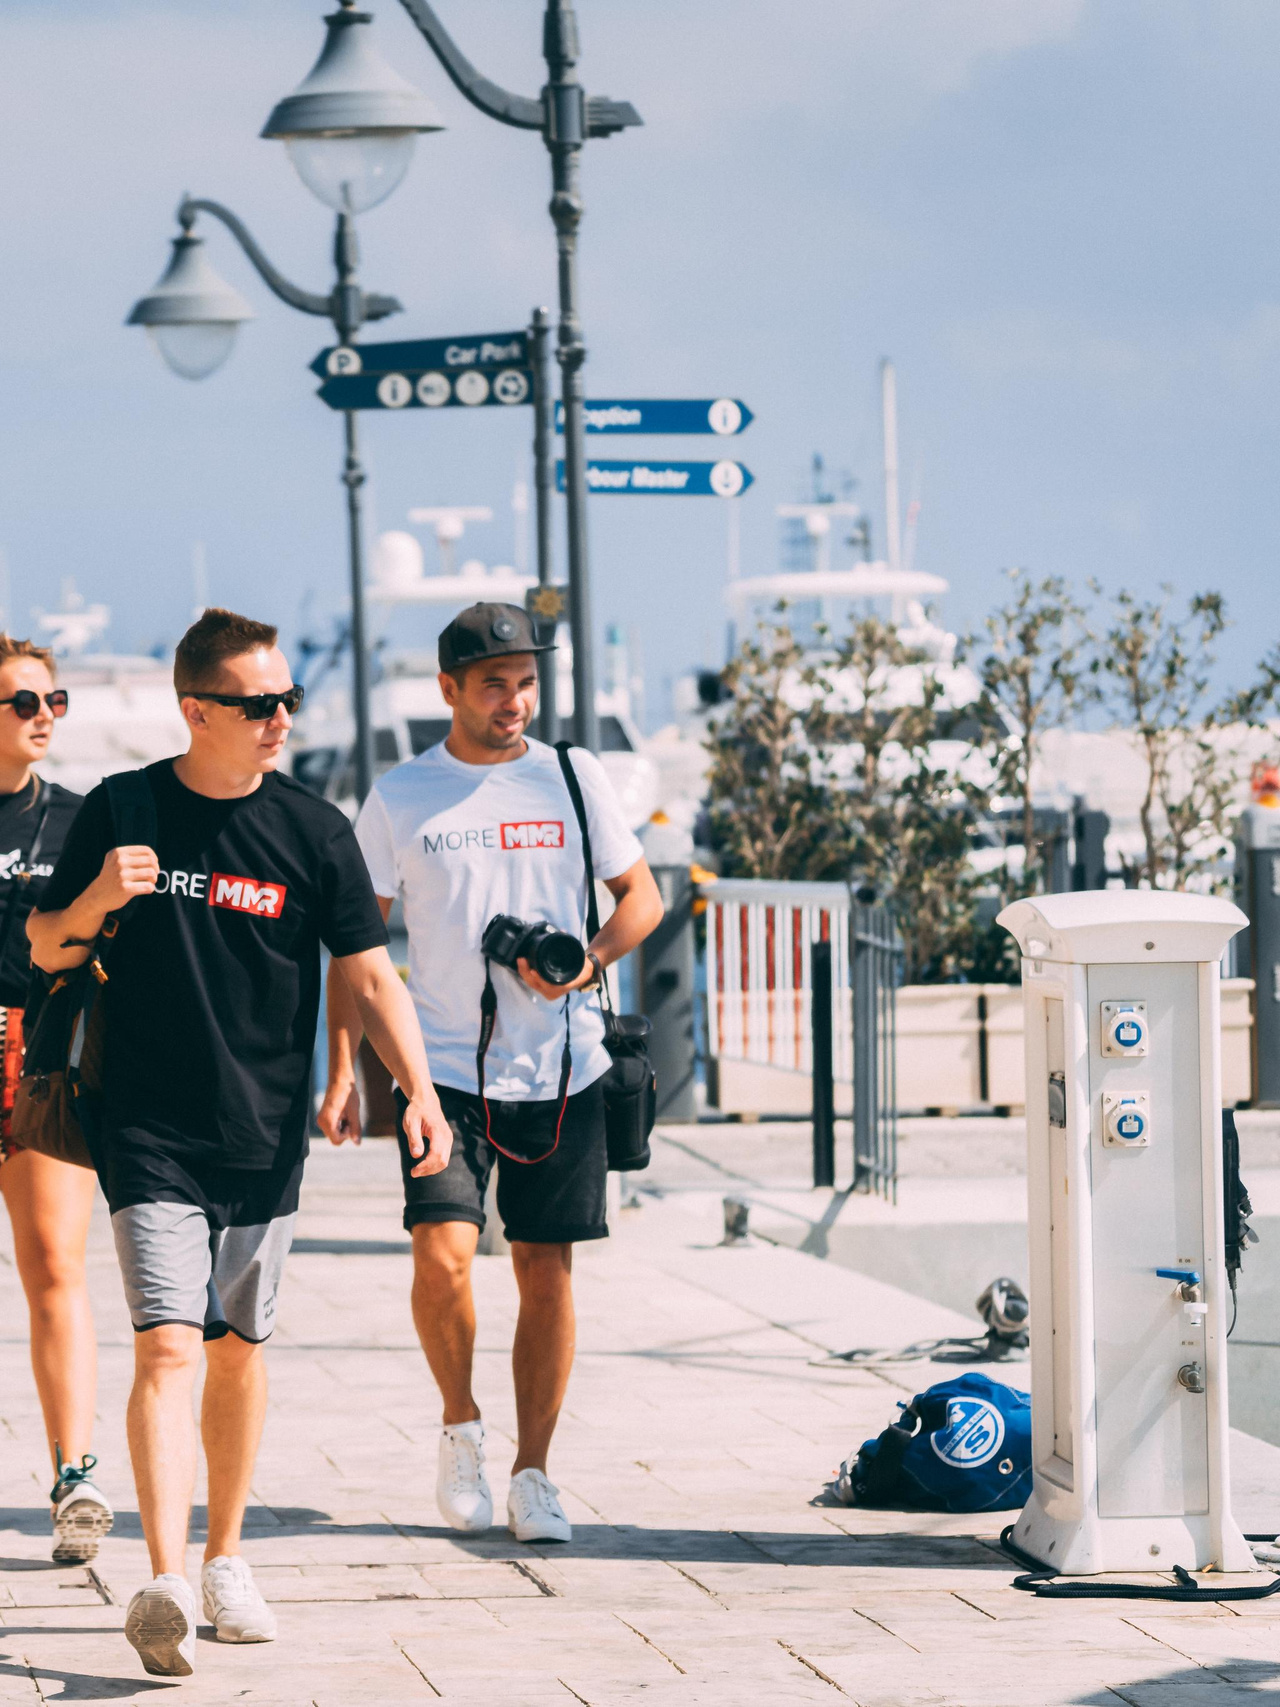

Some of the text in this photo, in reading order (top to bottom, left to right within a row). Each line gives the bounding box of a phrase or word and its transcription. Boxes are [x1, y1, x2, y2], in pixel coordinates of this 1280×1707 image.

[444, 345, 477, 366] Car
[480, 339, 521, 362] Park
[557, 405, 642, 430] eption
[576, 466, 689, 489] bour Master
[423, 823, 561, 854] MORE MMR
[154, 869, 279, 914] ORE MMR
